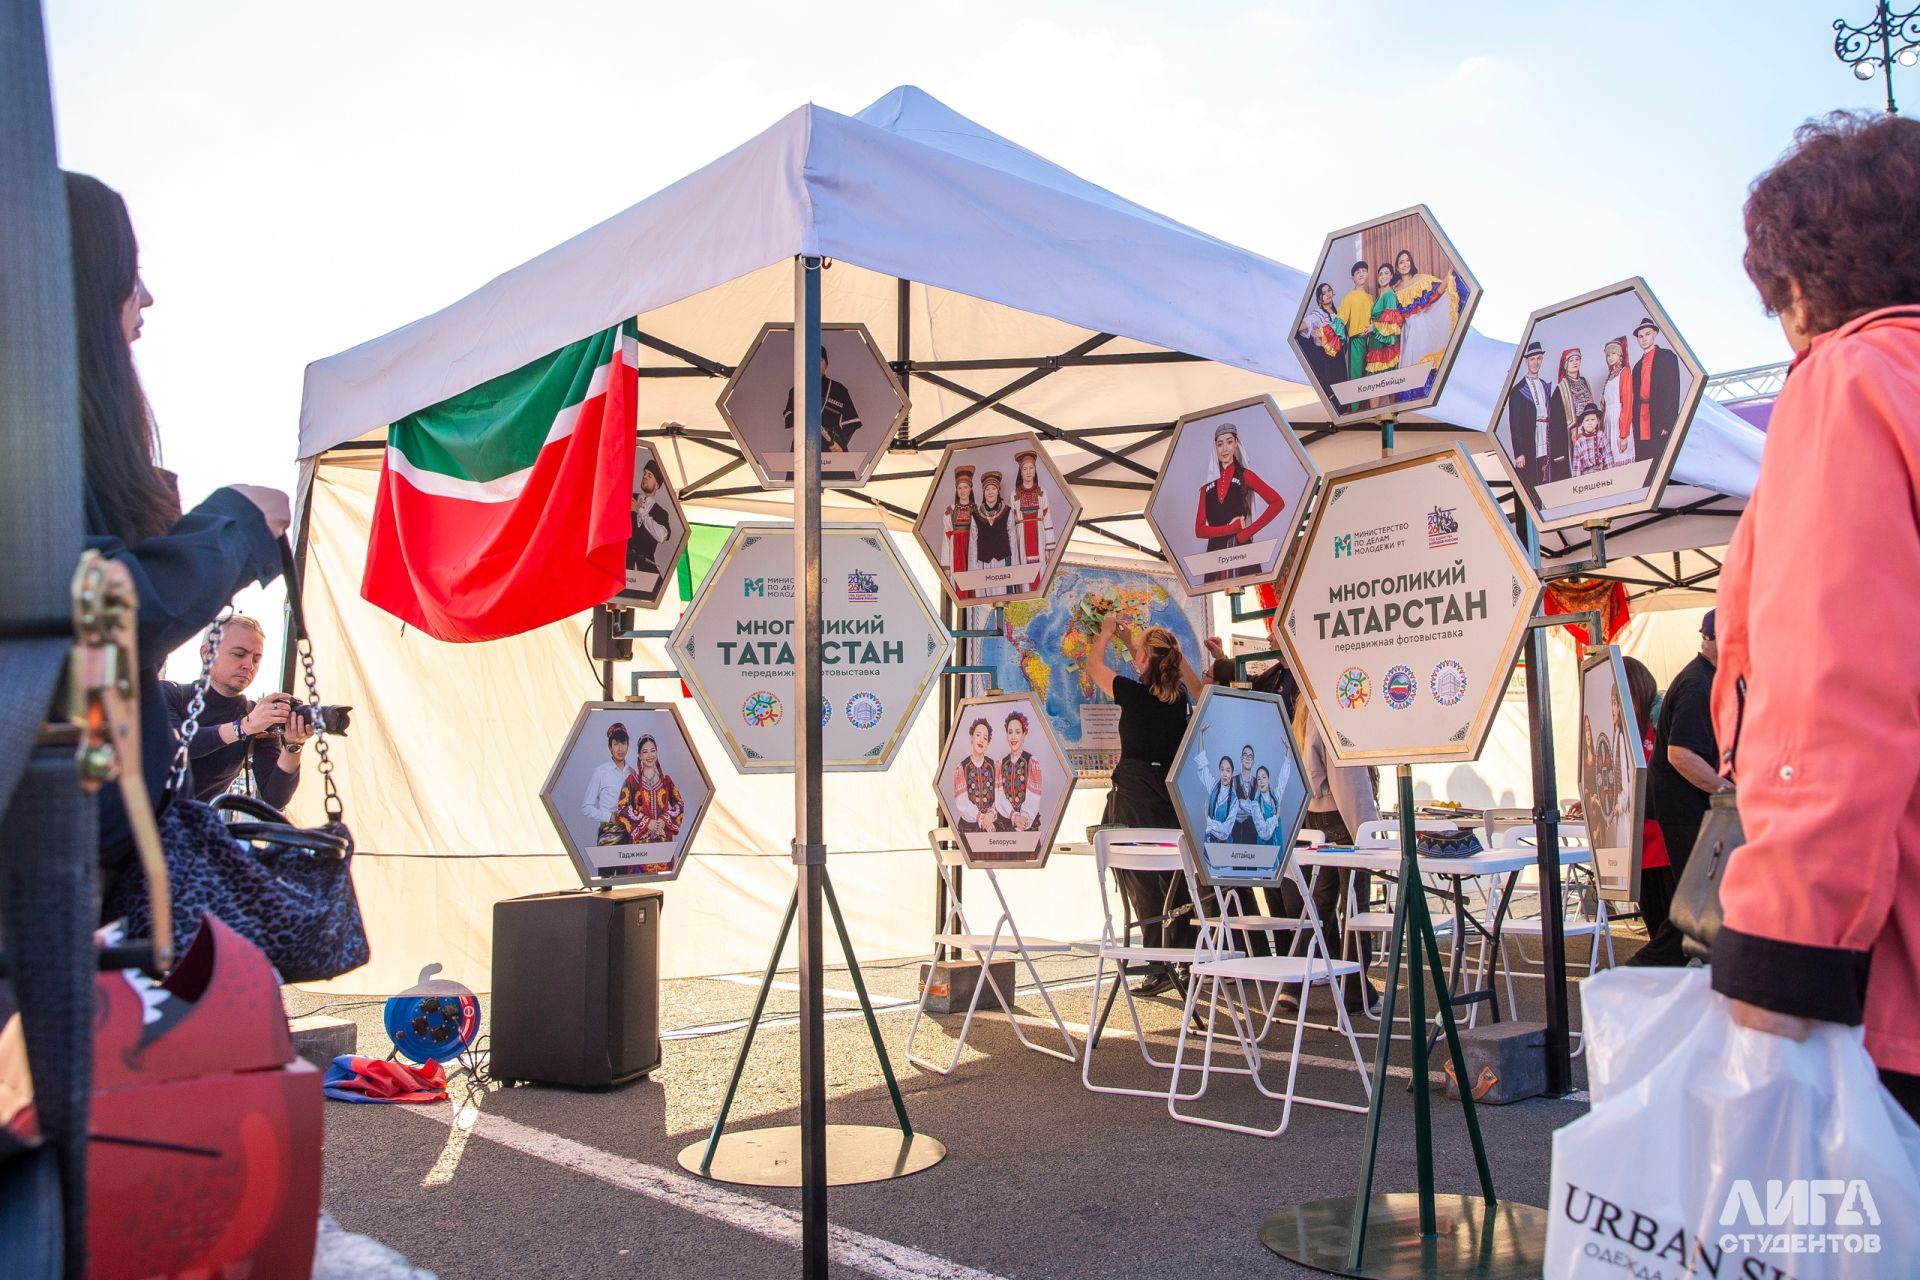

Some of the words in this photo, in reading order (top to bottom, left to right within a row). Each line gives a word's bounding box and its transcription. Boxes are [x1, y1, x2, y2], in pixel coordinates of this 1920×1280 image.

[1357, 376, 1406, 393] Колумбийцы
[1572, 477, 1613, 495] Кряшены
[1354, 522, 1409, 539] МИНИСТЕРСТВО
[1354, 539, 1364, 547] ПО
[1366, 535, 1390, 546] ДЕЛАМ
[1354, 542, 1395, 555] МОЛОДЕЖИ
[1397, 540, 1406, 548] РТ
[1217, 553, 1247, 564] Грузины
[985, 573, 1011, 582] Мордва
[1329, 559, 1466, 604] МНОГОЛИКИЙ
[1313, 589, 1487, 640] ТАТАРСТАН
[1335, 638, 1394, 653] передвижная
[1396, 629, 1463, 646] фотовыставка
[717, 641, 904, 666] ТАТАСТАН
[989, 838, 1017, 846] Белорусы
[617, 851, 648, 859] Таджики
[1231, 851, 1255, 859] Алтайцы
[1565, 1181, 1725, 1280] URBAN
